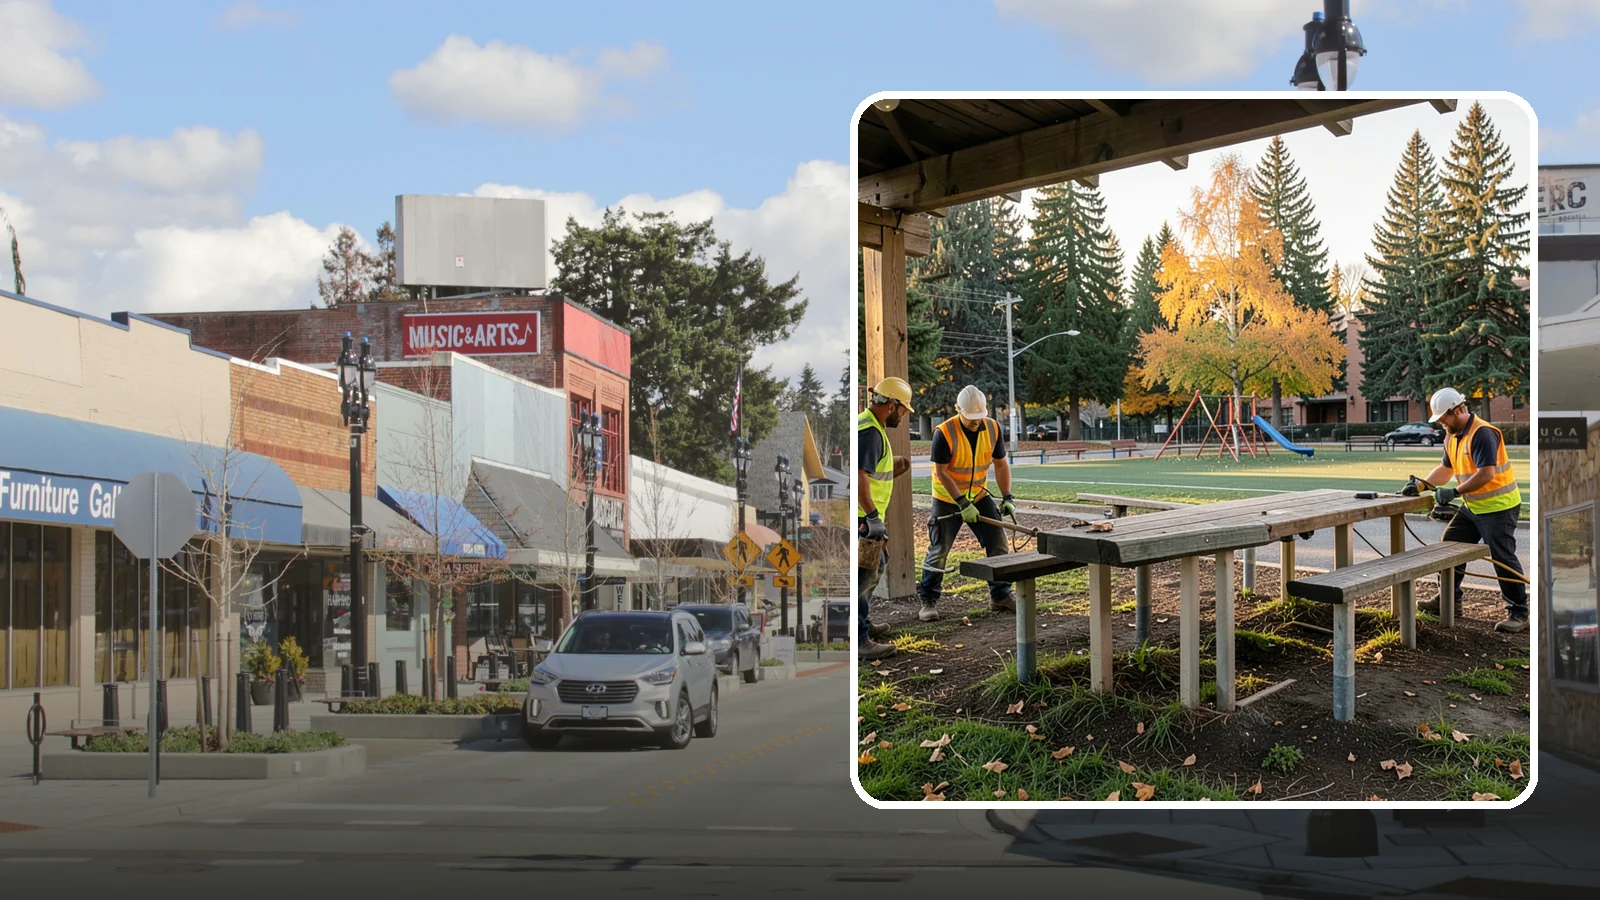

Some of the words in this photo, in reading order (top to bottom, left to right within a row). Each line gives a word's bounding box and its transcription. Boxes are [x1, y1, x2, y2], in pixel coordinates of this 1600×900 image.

[1540, 428, 1577, 436] UGA
[0, 471, 79, 515] Furniture
[90, 482, 121, 519] Gal
[454, 563, 479, 574] SUSHI
